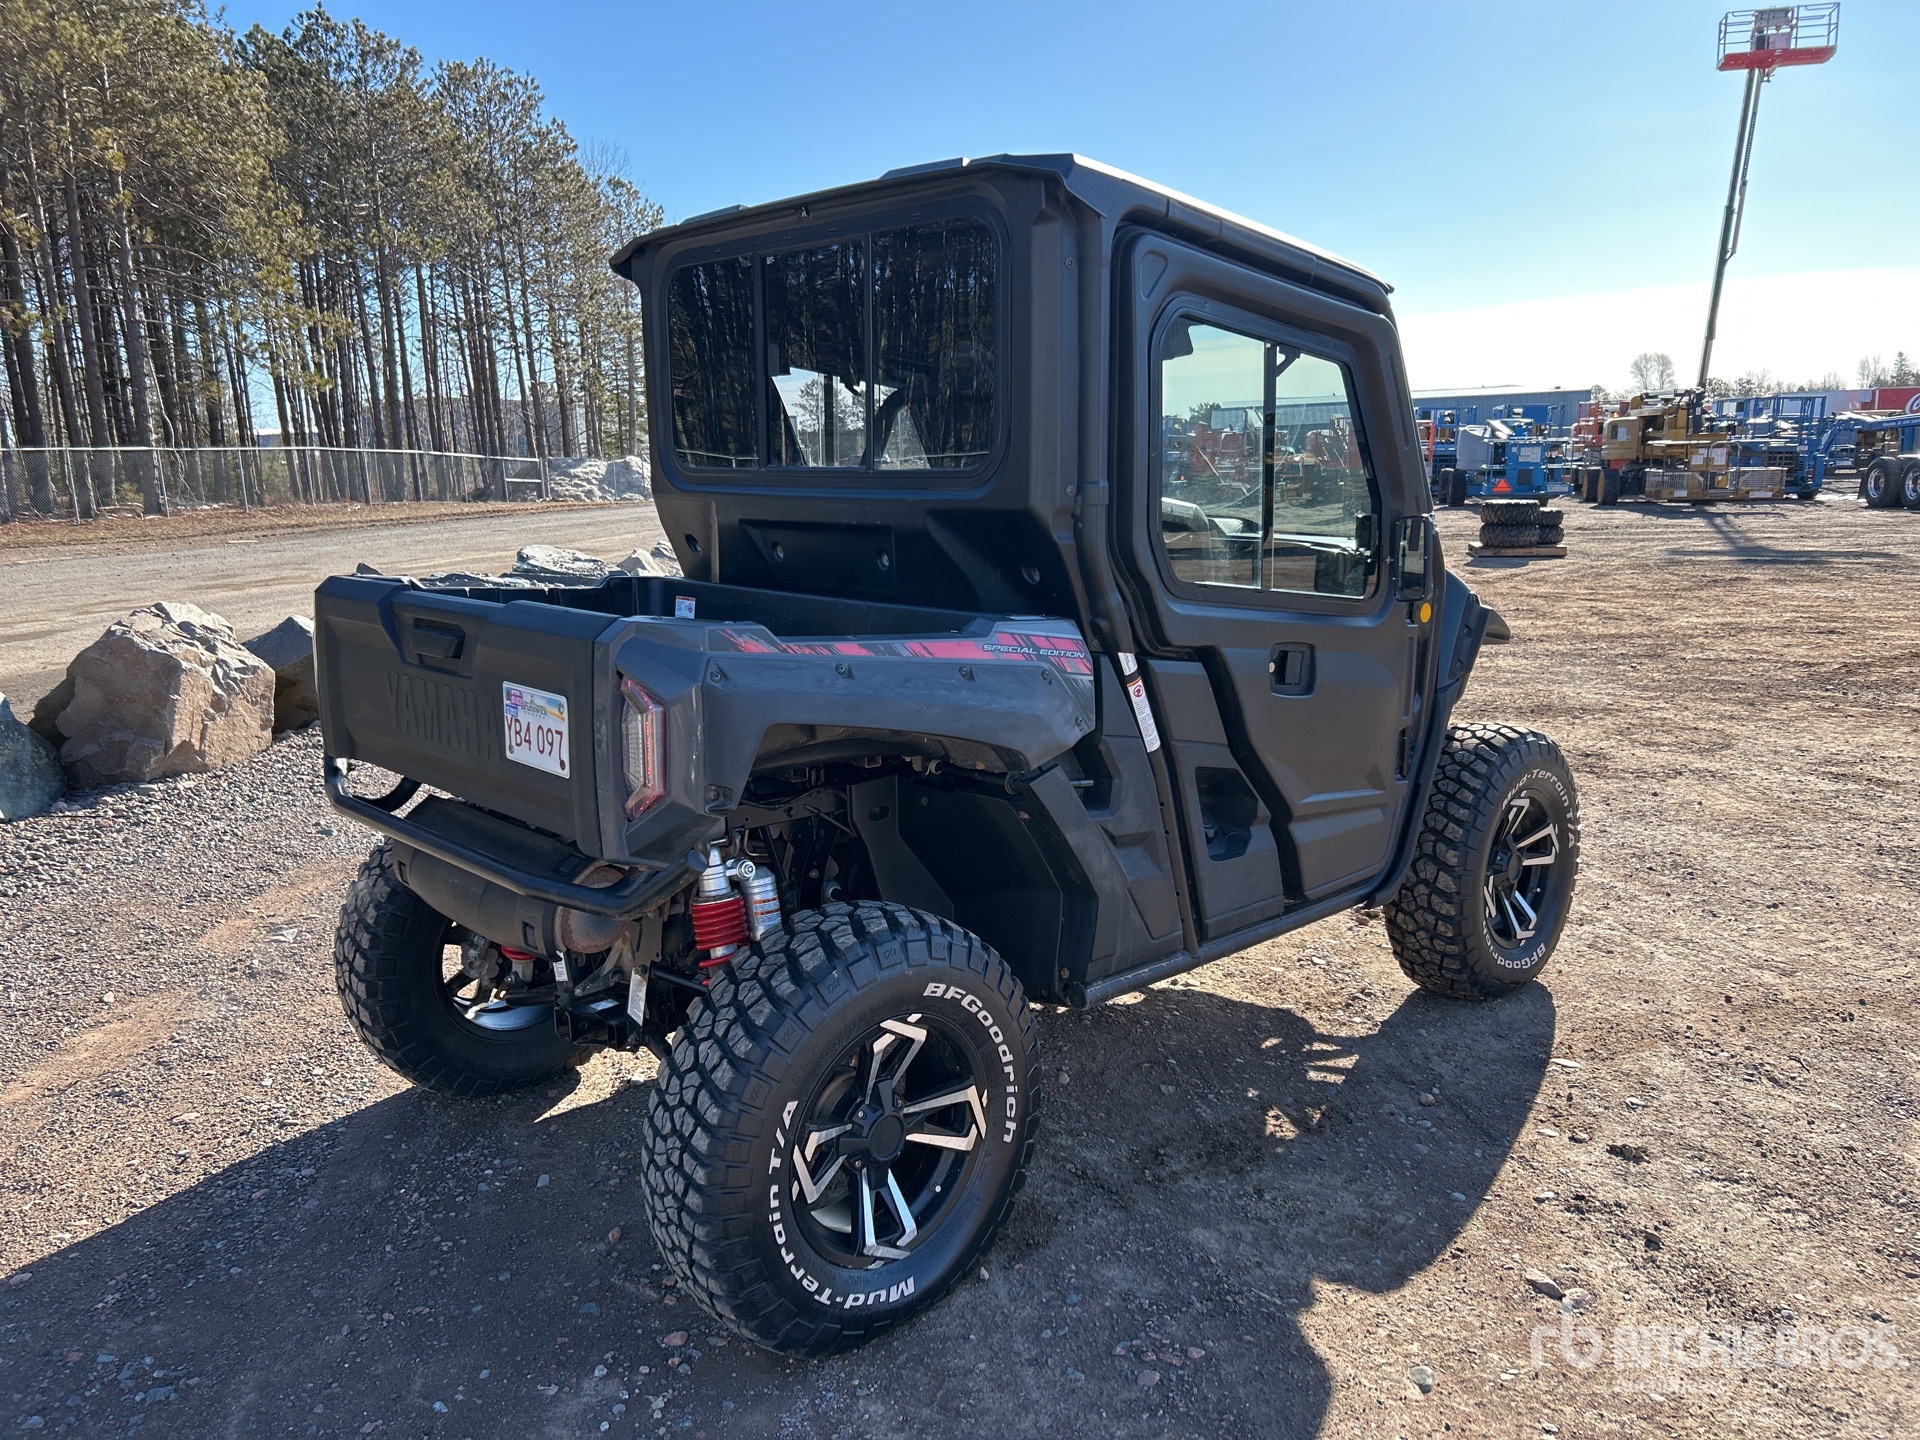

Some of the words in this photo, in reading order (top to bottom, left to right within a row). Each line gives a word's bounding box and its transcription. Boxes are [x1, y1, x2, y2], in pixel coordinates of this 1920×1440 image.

[983, 643, 1037, 655] SPECIAL
[1040, 648, 1085, 659] EDITION
[384, 670, 503, 763] YAMAHA
[505, 715, 532, 752] YB4
[536, 725, 563, 762] 097
[1482, 920, 1546, 969] BFGoodrich
[923, 982, 1018, 1143] BFGoodrich
[769, 1101, 798, 1174] T/A
